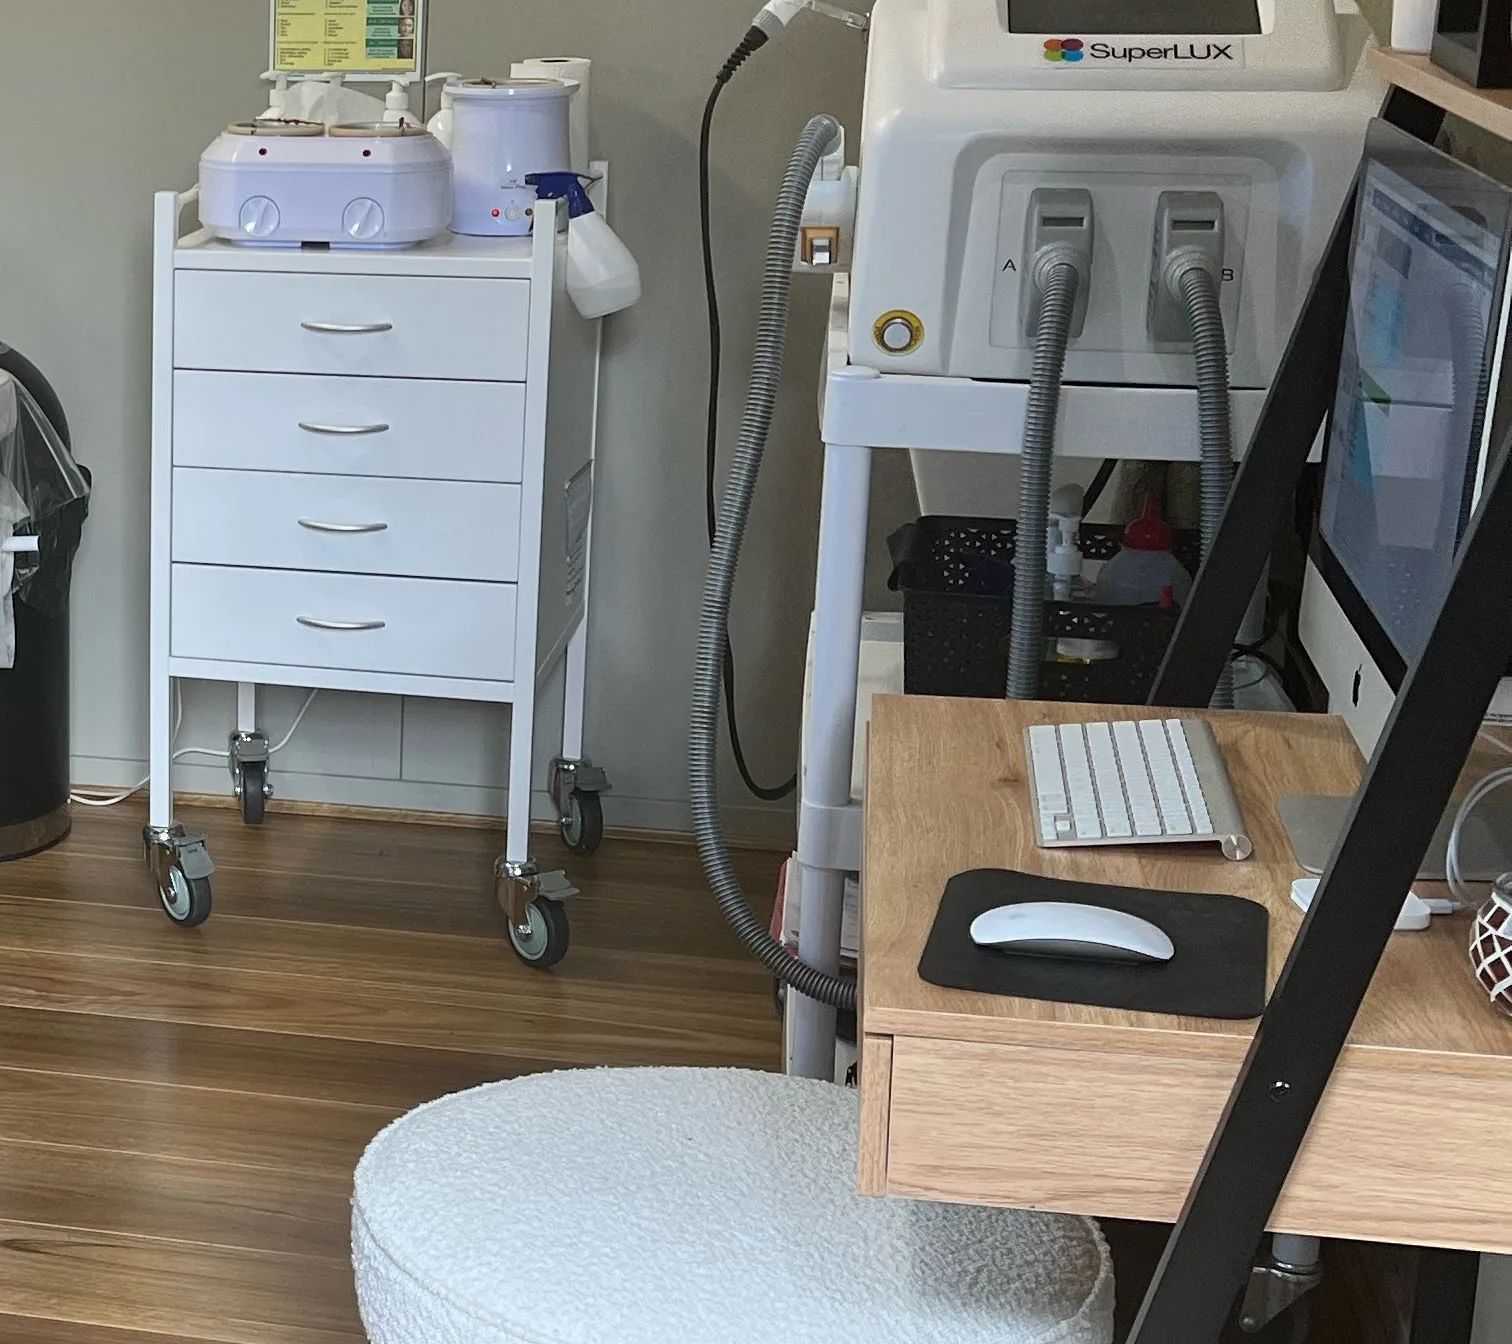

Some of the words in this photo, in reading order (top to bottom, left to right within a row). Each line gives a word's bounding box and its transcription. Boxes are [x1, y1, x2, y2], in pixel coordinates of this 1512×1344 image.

[1090, 43, 1234, 63] SuperLUX
[1002, 258, 1017, 272] A
[1221, 268, 1234, 282] B
